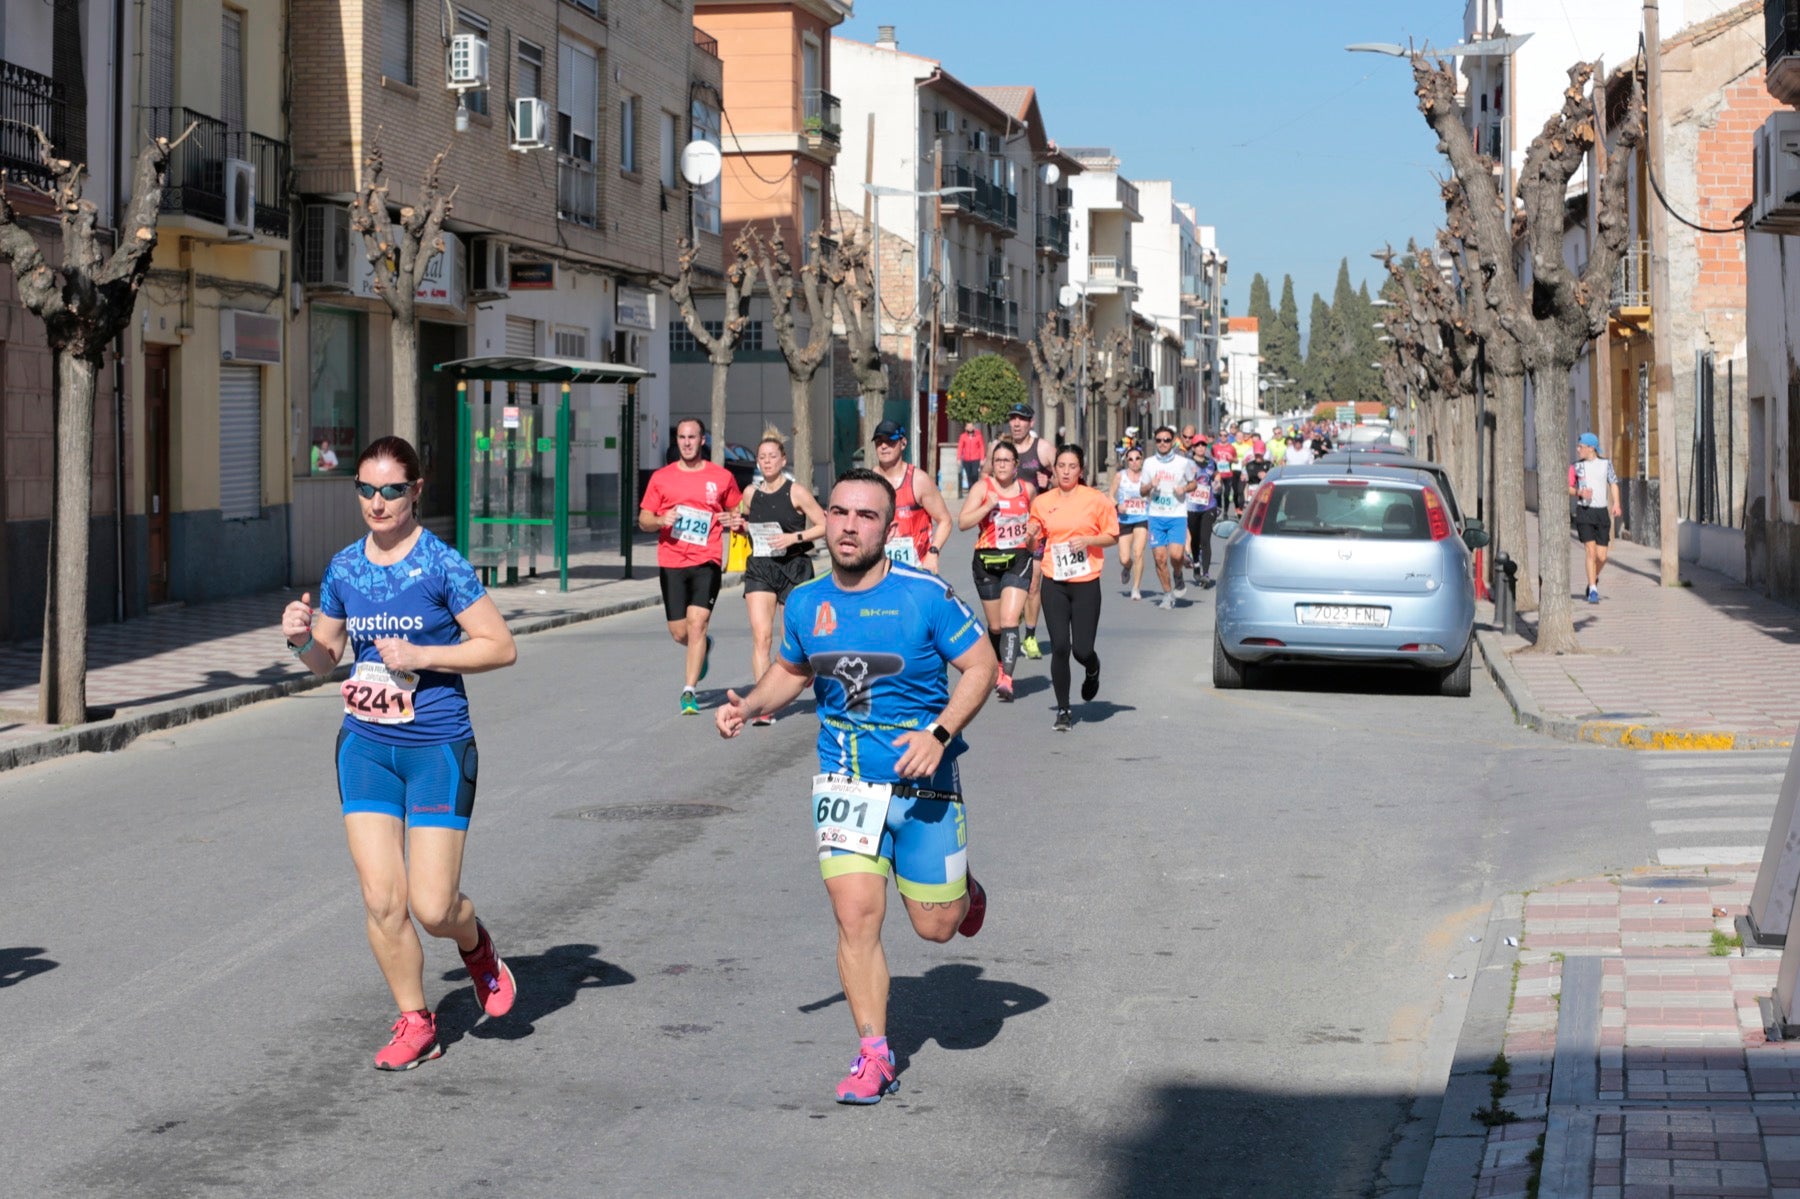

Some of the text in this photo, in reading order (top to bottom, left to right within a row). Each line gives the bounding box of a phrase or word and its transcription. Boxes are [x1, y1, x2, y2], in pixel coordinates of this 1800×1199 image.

[676, 515, 708, 535] 1129
[1056, 551, 1085, 567] 3128
[1314, 606, 1381, 622] 7023 FNL
[345, 684, 406, 714] 2241
[816, 796, 868, 828] 601
